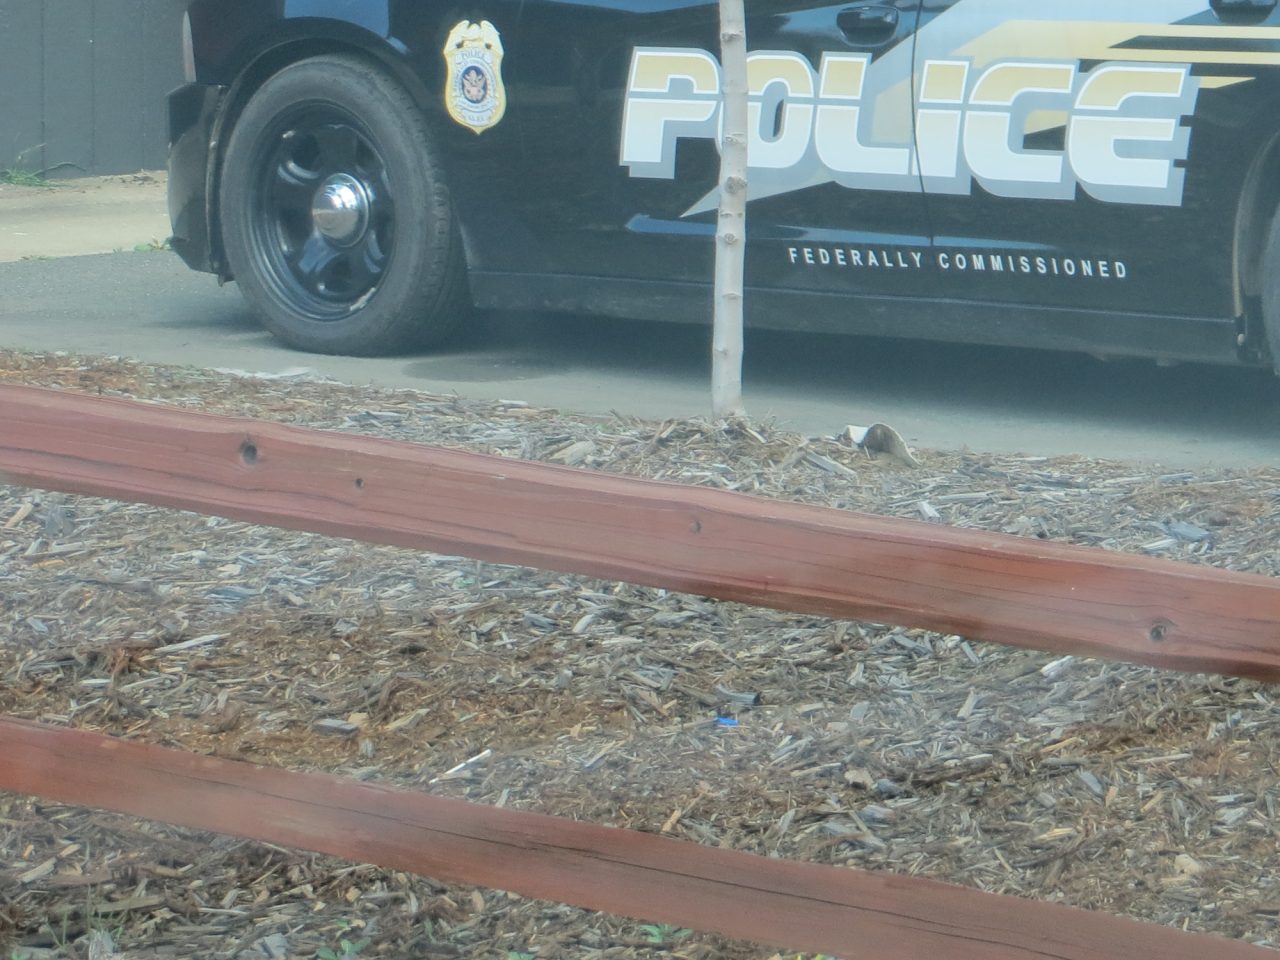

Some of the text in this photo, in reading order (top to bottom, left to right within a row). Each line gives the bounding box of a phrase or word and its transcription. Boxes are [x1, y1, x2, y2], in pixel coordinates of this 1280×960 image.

[619, 45, 1200, 207] POLICE
[788, 247, 1127, 278] FEDERALLY COMMISSIONED
